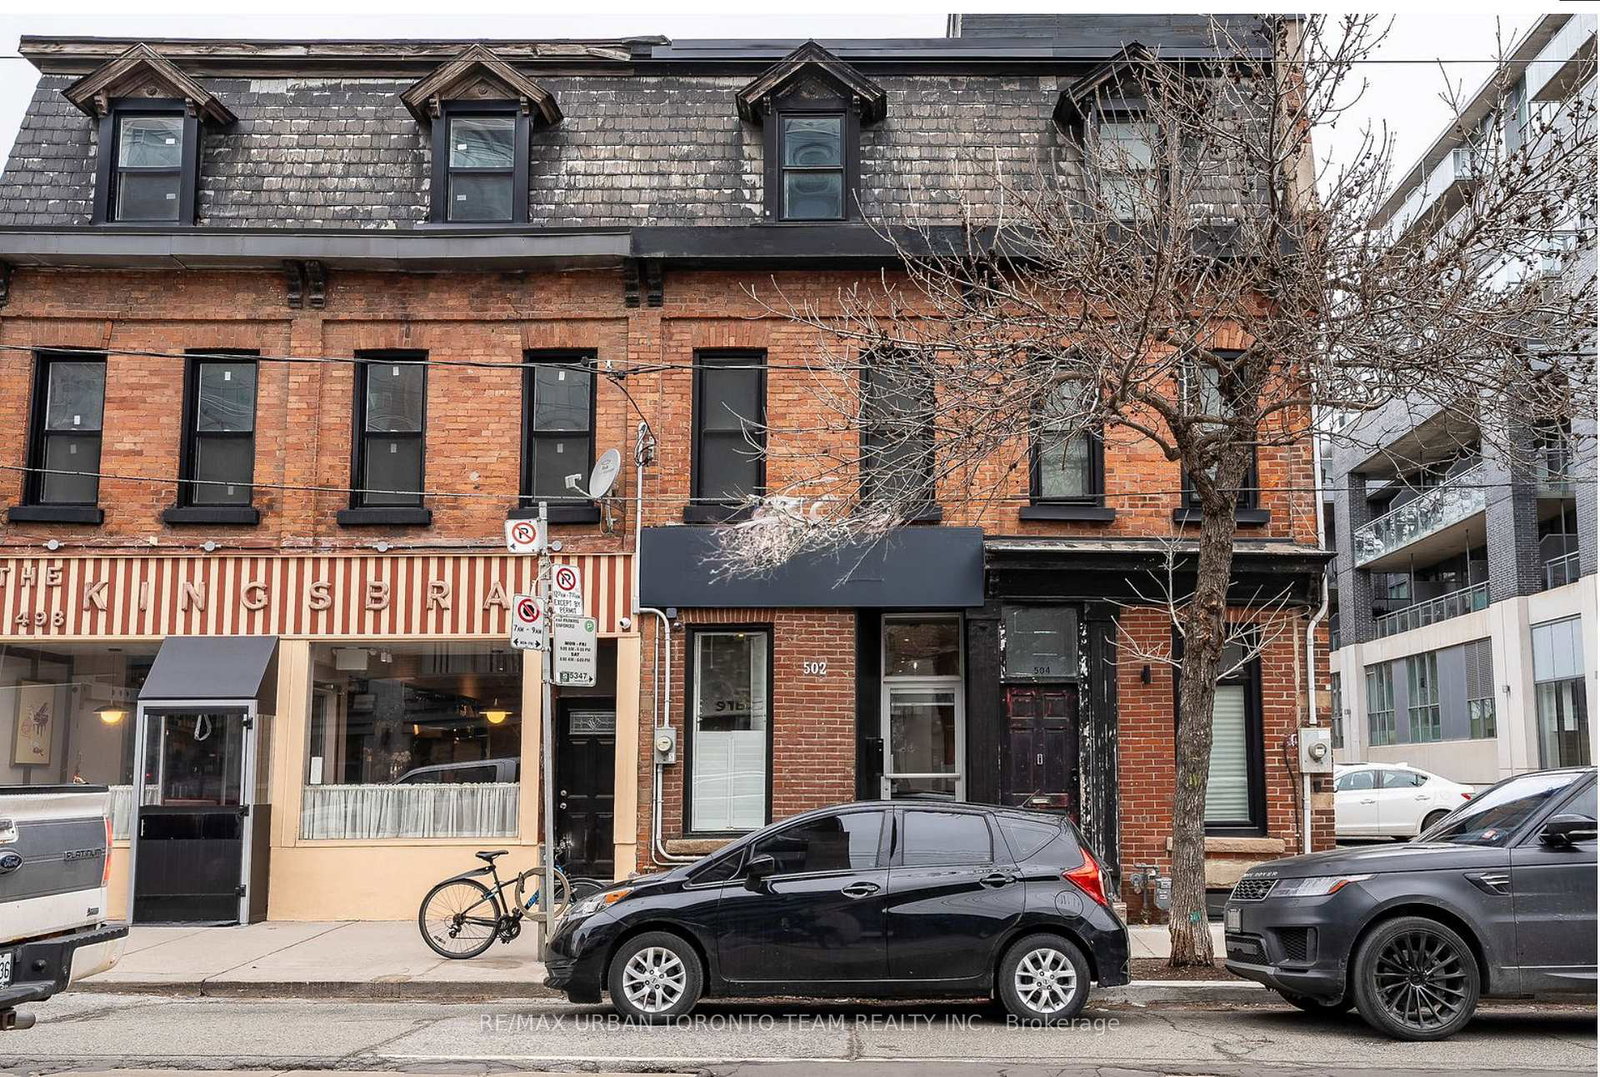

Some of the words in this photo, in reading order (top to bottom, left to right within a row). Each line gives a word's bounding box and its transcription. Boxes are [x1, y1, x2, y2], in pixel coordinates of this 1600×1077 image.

[0, 566, 63, 588] THE
[83, 581, 537, 612] KINGSBRA
[14, 611, 65, 627] 498
[569, 671, 588, 679] 5347
[803, 661, 827, 675] 502
[1033, 666, 1051, 675] 504
[65, 848, 102, 860] PLATINUM
